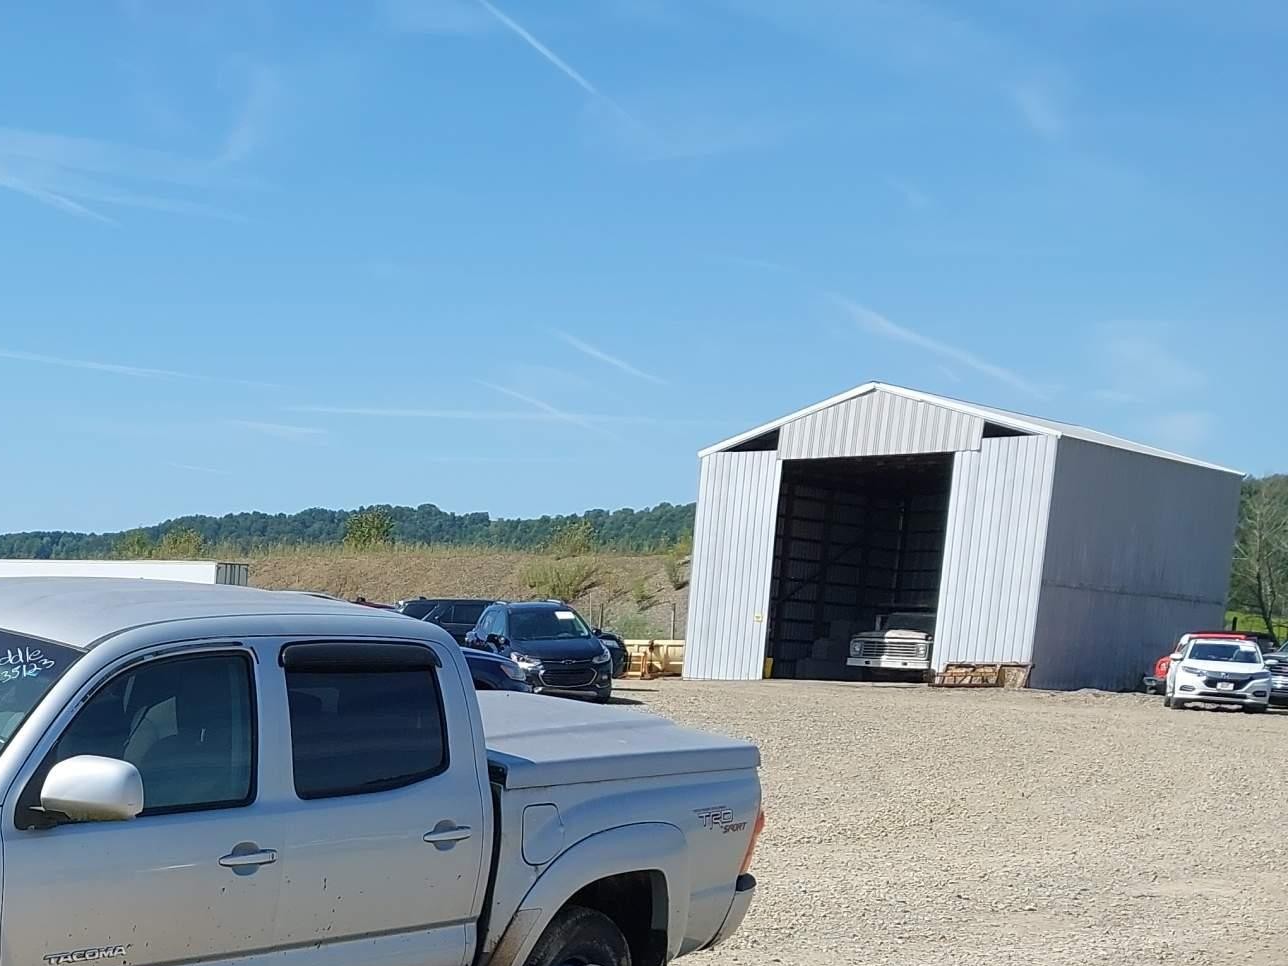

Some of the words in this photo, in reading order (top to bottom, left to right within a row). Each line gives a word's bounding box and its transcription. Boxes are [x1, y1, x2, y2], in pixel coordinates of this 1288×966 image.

[697, 808, 734, 830] TRD
[722, 821, 747, 834] SPORT
[43, 945, 128, 965] TACOMA
